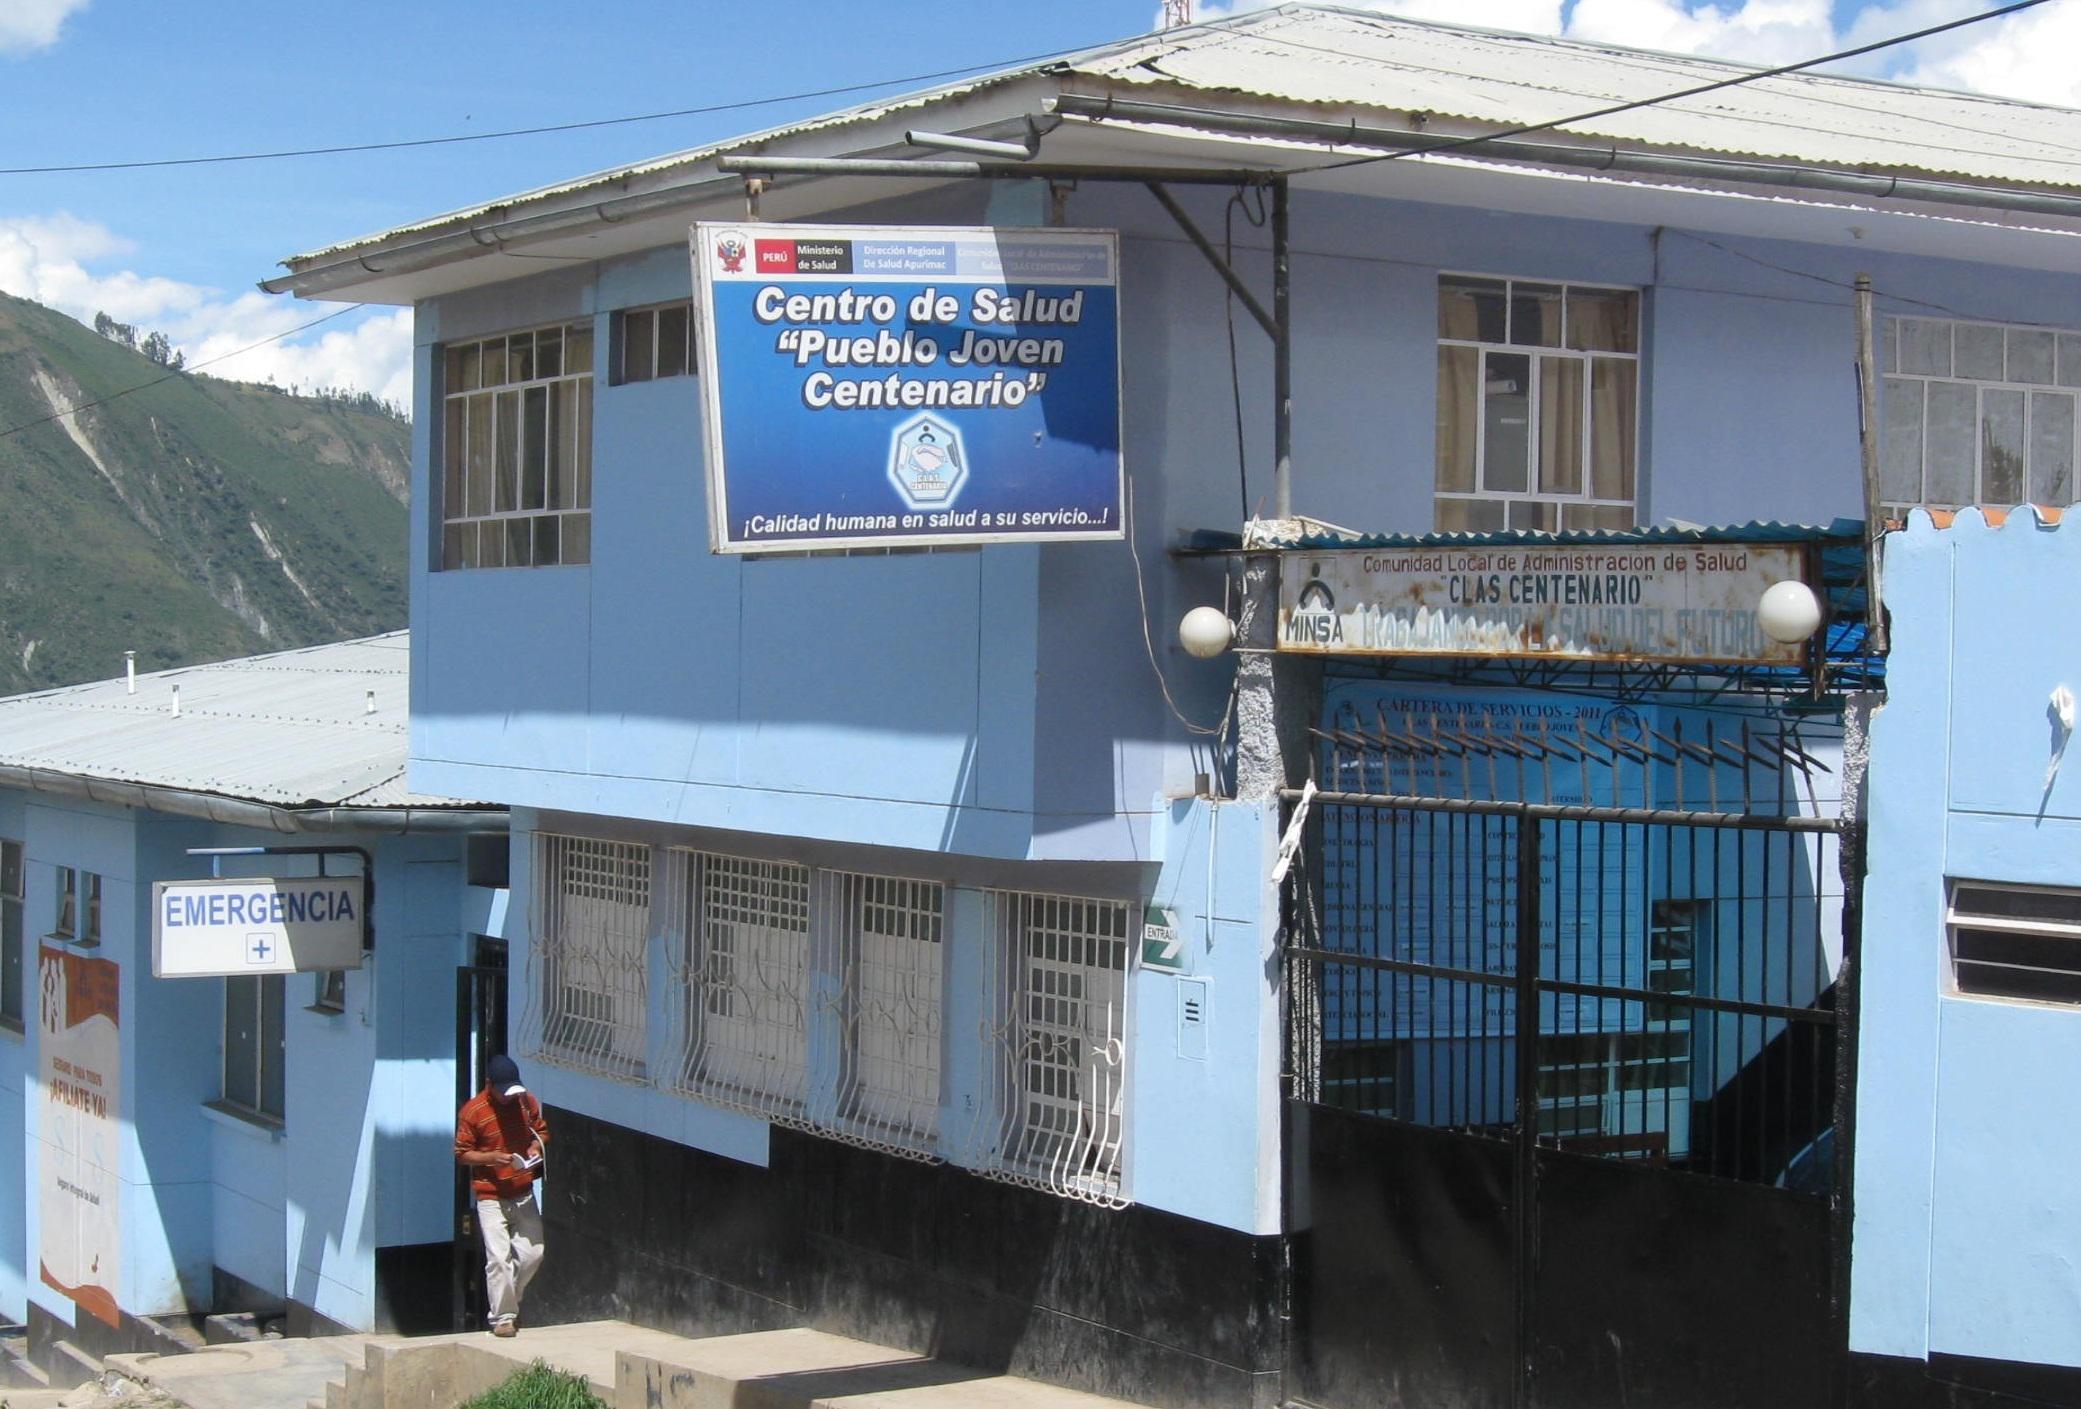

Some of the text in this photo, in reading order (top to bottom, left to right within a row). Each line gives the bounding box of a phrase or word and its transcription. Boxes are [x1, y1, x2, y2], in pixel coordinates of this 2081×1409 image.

[762, 250, 788, 263] PERÚ
[797, 245, 844, 255] Ministerio
[863, 245, 945, 258] Dirección Regional
[798, 260, 837, 270] de Salud
[863, 259, 876, 269] De
[877, 258, 903, 269] Salud
[754, 286, 1084, 324] Centro de Salud
[777, 329, 1065, 367] “Pueblo Joven
[803, 371, 1047, 409] Centenario”
[743, 507, 1109, 539] ¡Calidad humana en salud a su servicio...!
[1363, 552, 1748, 574] Comunidad Local de Administracion de Salud
[1285, 614, 1345, 645] MINSA
[1559, 606, 1628, 652] SALUD
[1630, 607, 1672, 654] DEL
[1675, 607, 1766, 656] FUTURO
[1376, 699, 1454, 716] CARTERA
[1456, 703, 1473, 717] DE
[1482, 703, 1563, 719] SERVICIOS
[1572, 705, 1602, 720] 2011
[165, 890, 355, 928] EMERGENCIA
